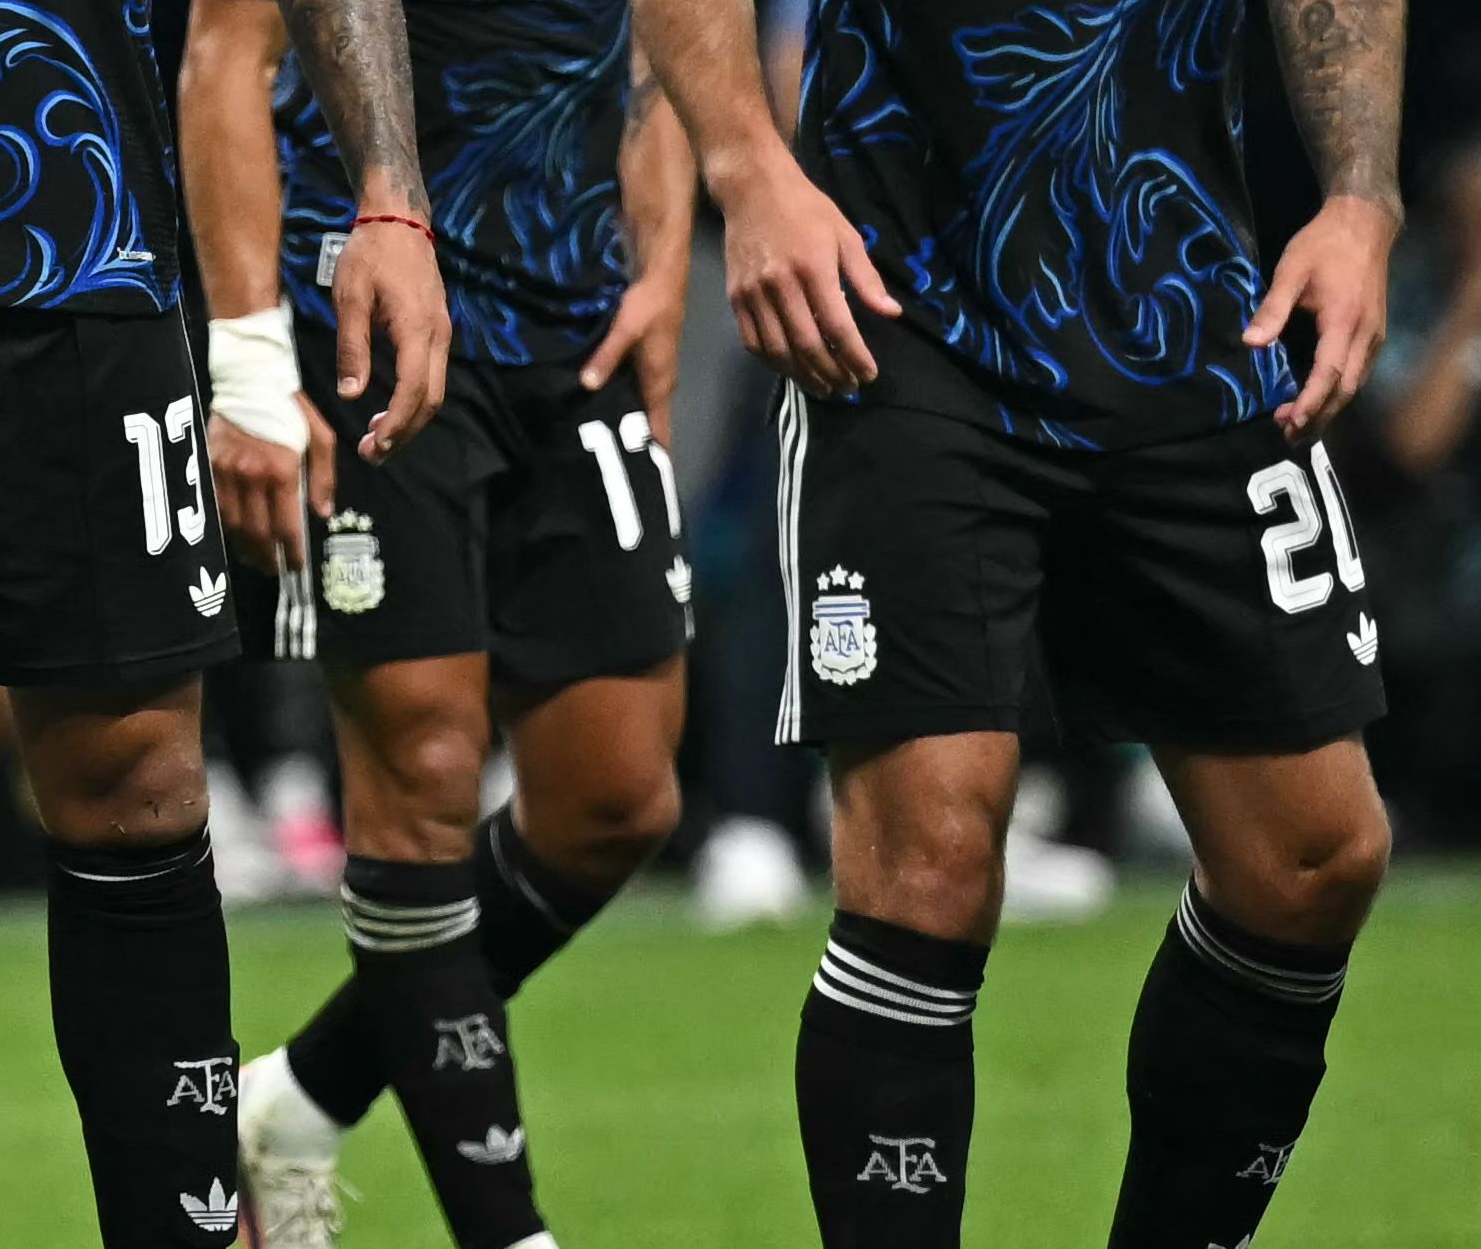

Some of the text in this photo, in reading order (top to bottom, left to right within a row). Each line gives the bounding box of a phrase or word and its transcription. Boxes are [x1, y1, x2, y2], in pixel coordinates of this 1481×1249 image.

[123, 395, 206, 556] 13
[578, 410, 682, 551] 17
[824, 619, 861, 658] AFA
[166, 1056, 237, 1115] AFA
[857, 1133, 947, 1194] AFA
